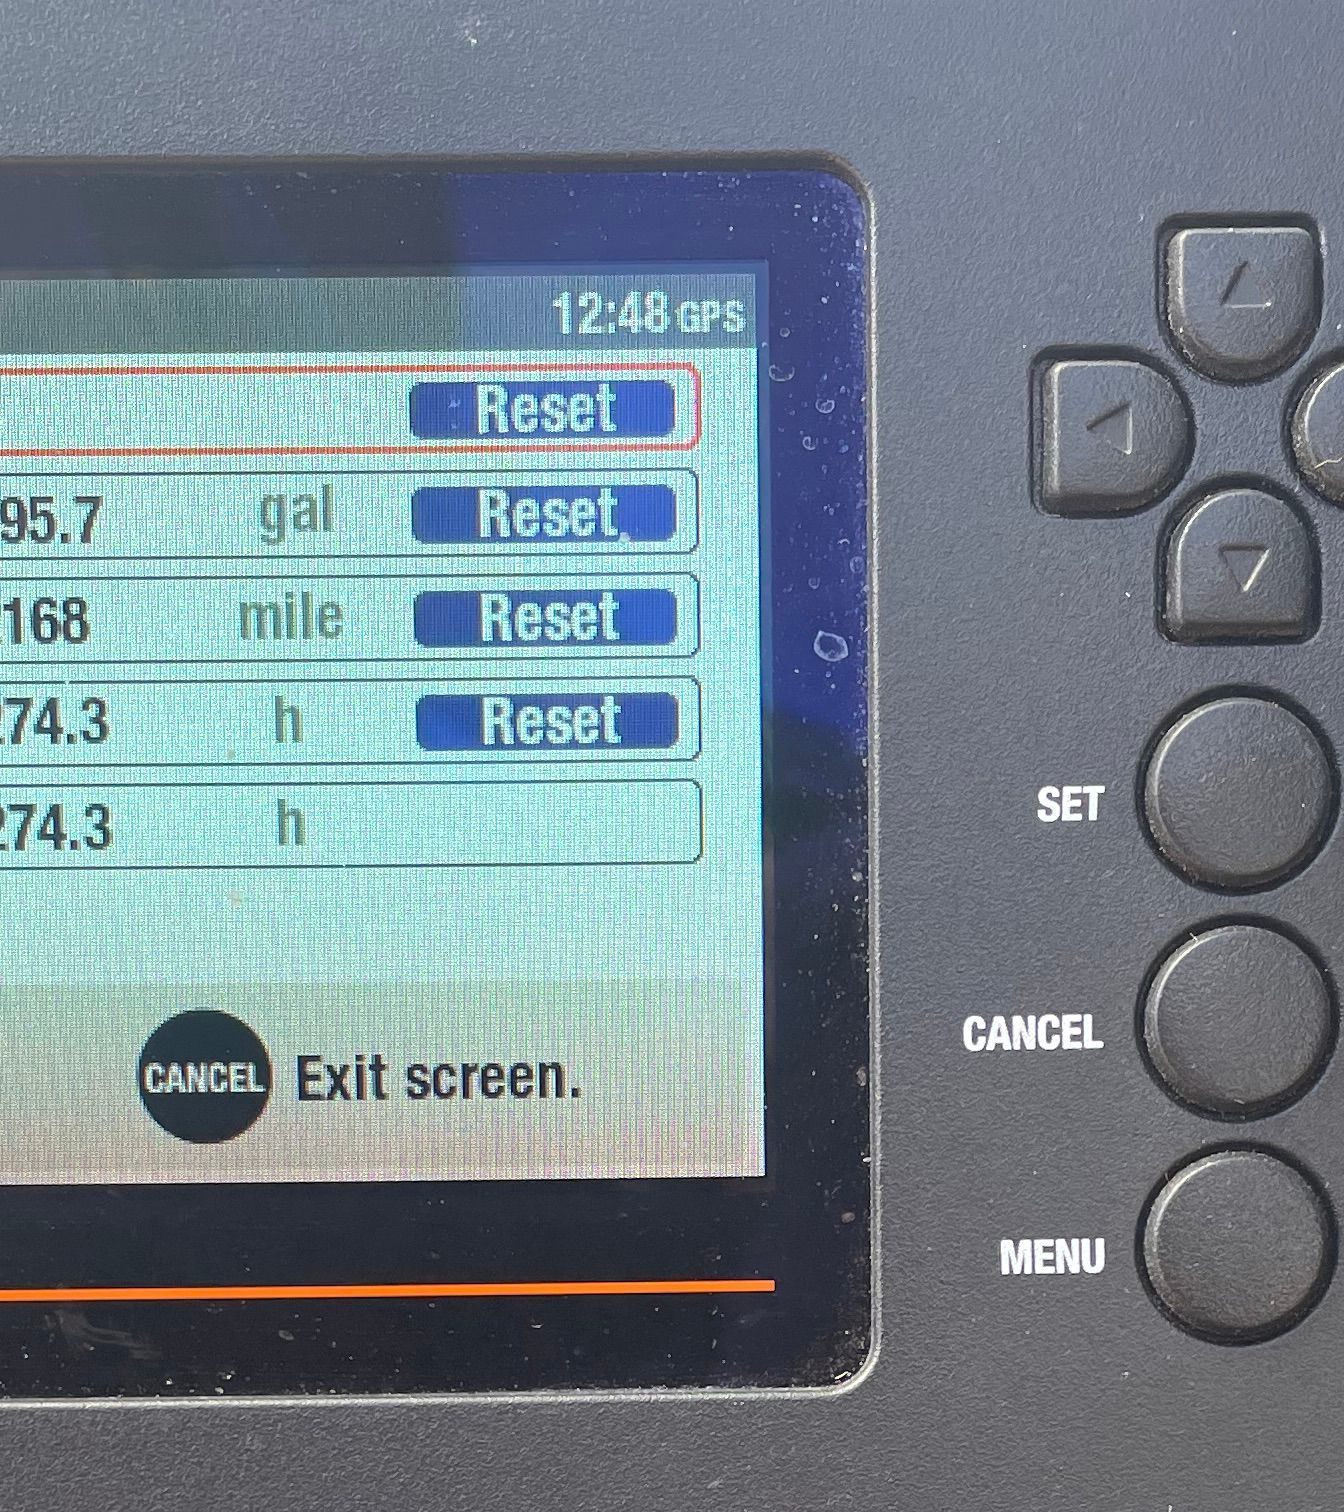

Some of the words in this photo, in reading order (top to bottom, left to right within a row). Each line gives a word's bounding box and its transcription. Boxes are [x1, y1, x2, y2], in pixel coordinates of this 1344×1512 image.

[552, 291, 669, 335] 12:48
[675, 298, 747, 334] GPS
[475, 383, 618, 435] Reset
[259, 485, 334, 546] gal
[477, 488, 619, 539] Reset
[240, 592, 343, 642] mile
[479, 592, 620, 642] Reset
[274, 695, 304, 744] h
[481, 694, 622, 745] Reset
[277, 799, 306, 846] h
[1037, 785, 1106, 822] SET
[962, 1014, 1105, 1052] CANCEL
[142, 1061, 267, 1094] CANCEL
[297, 1054, 389, 1101] Exit
[406, 1056, 583, 1100] screen.
[999, 1237, 1106, 1275] MENU
